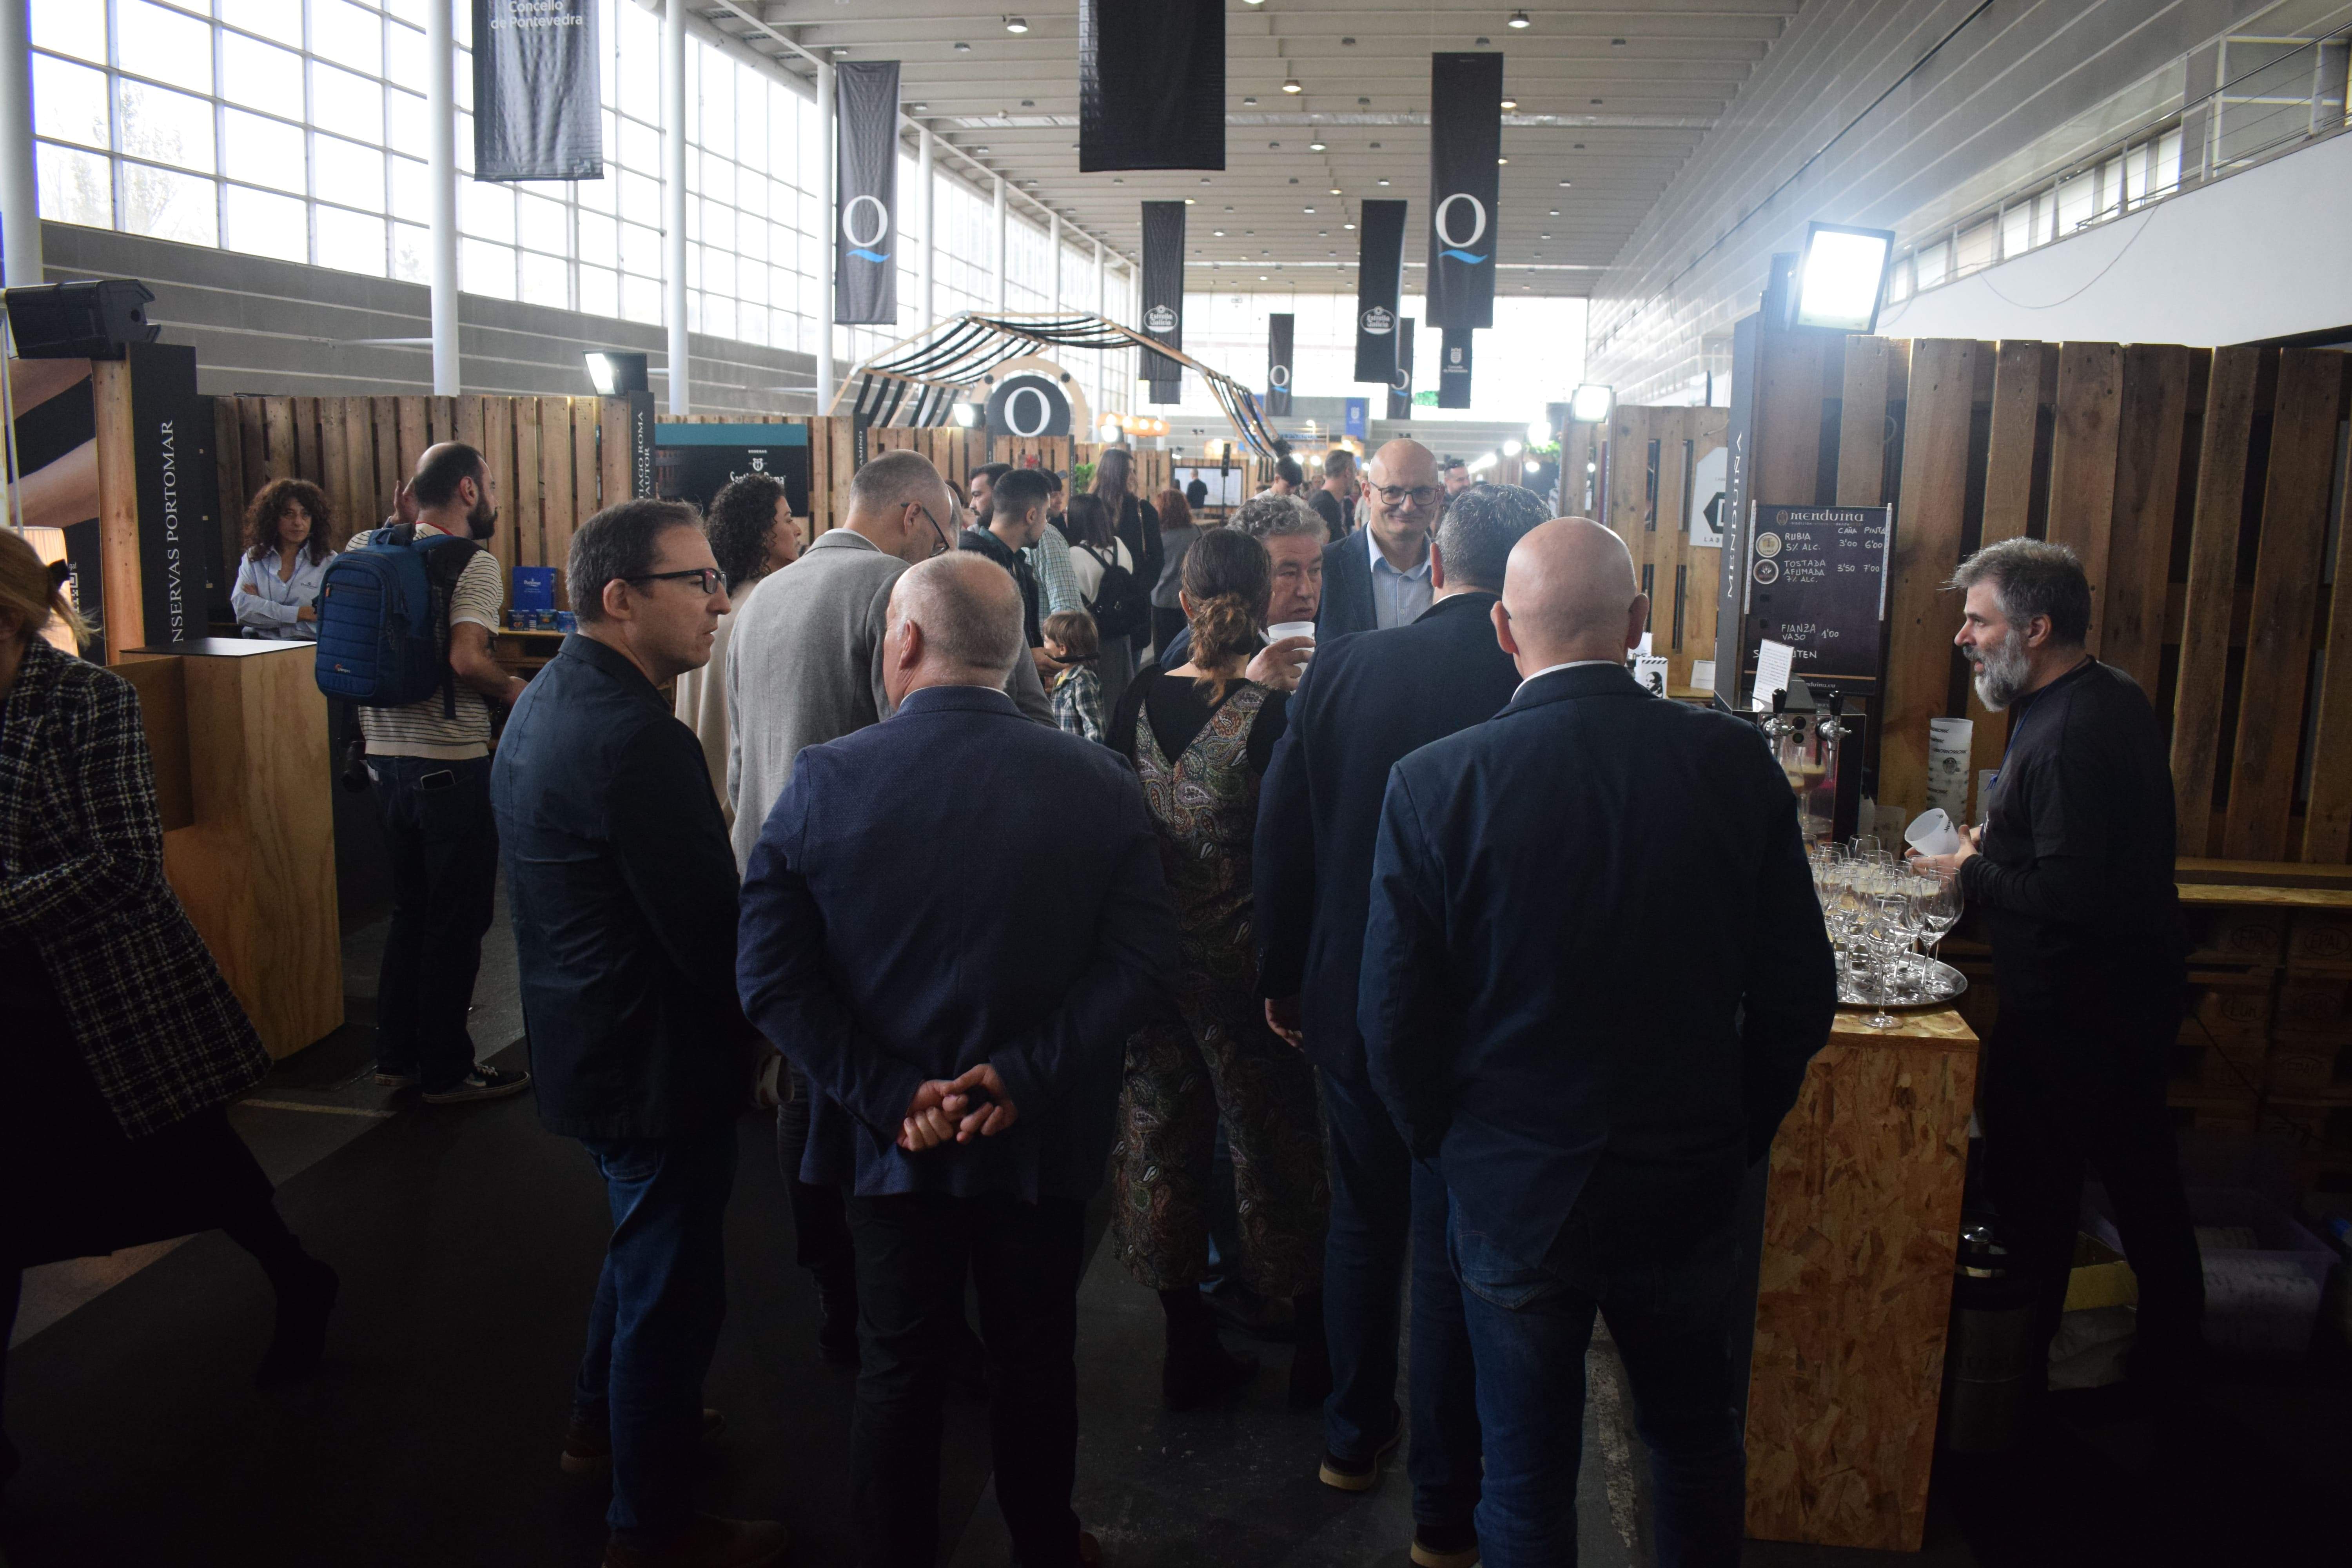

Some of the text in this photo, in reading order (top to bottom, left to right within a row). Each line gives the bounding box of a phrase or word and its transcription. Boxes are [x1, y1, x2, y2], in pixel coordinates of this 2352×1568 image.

[509, 0, 563, 13] Concello
[490, 13, 583, 29] de Pontevedra
[1728, 431, 1742, 599] MENDUIÑA
[1790, 509, 1864, 521] menduiña
[162, 420, 184, 643] NSERVAS PORTOMAR
[1865, 540, 1883, 548] 6'00
[1781, 623, 1815, 633] FIANZA
[1821, 628, 1839, 639] 1'00
[2311, 933, 2343, 950] EPAL
